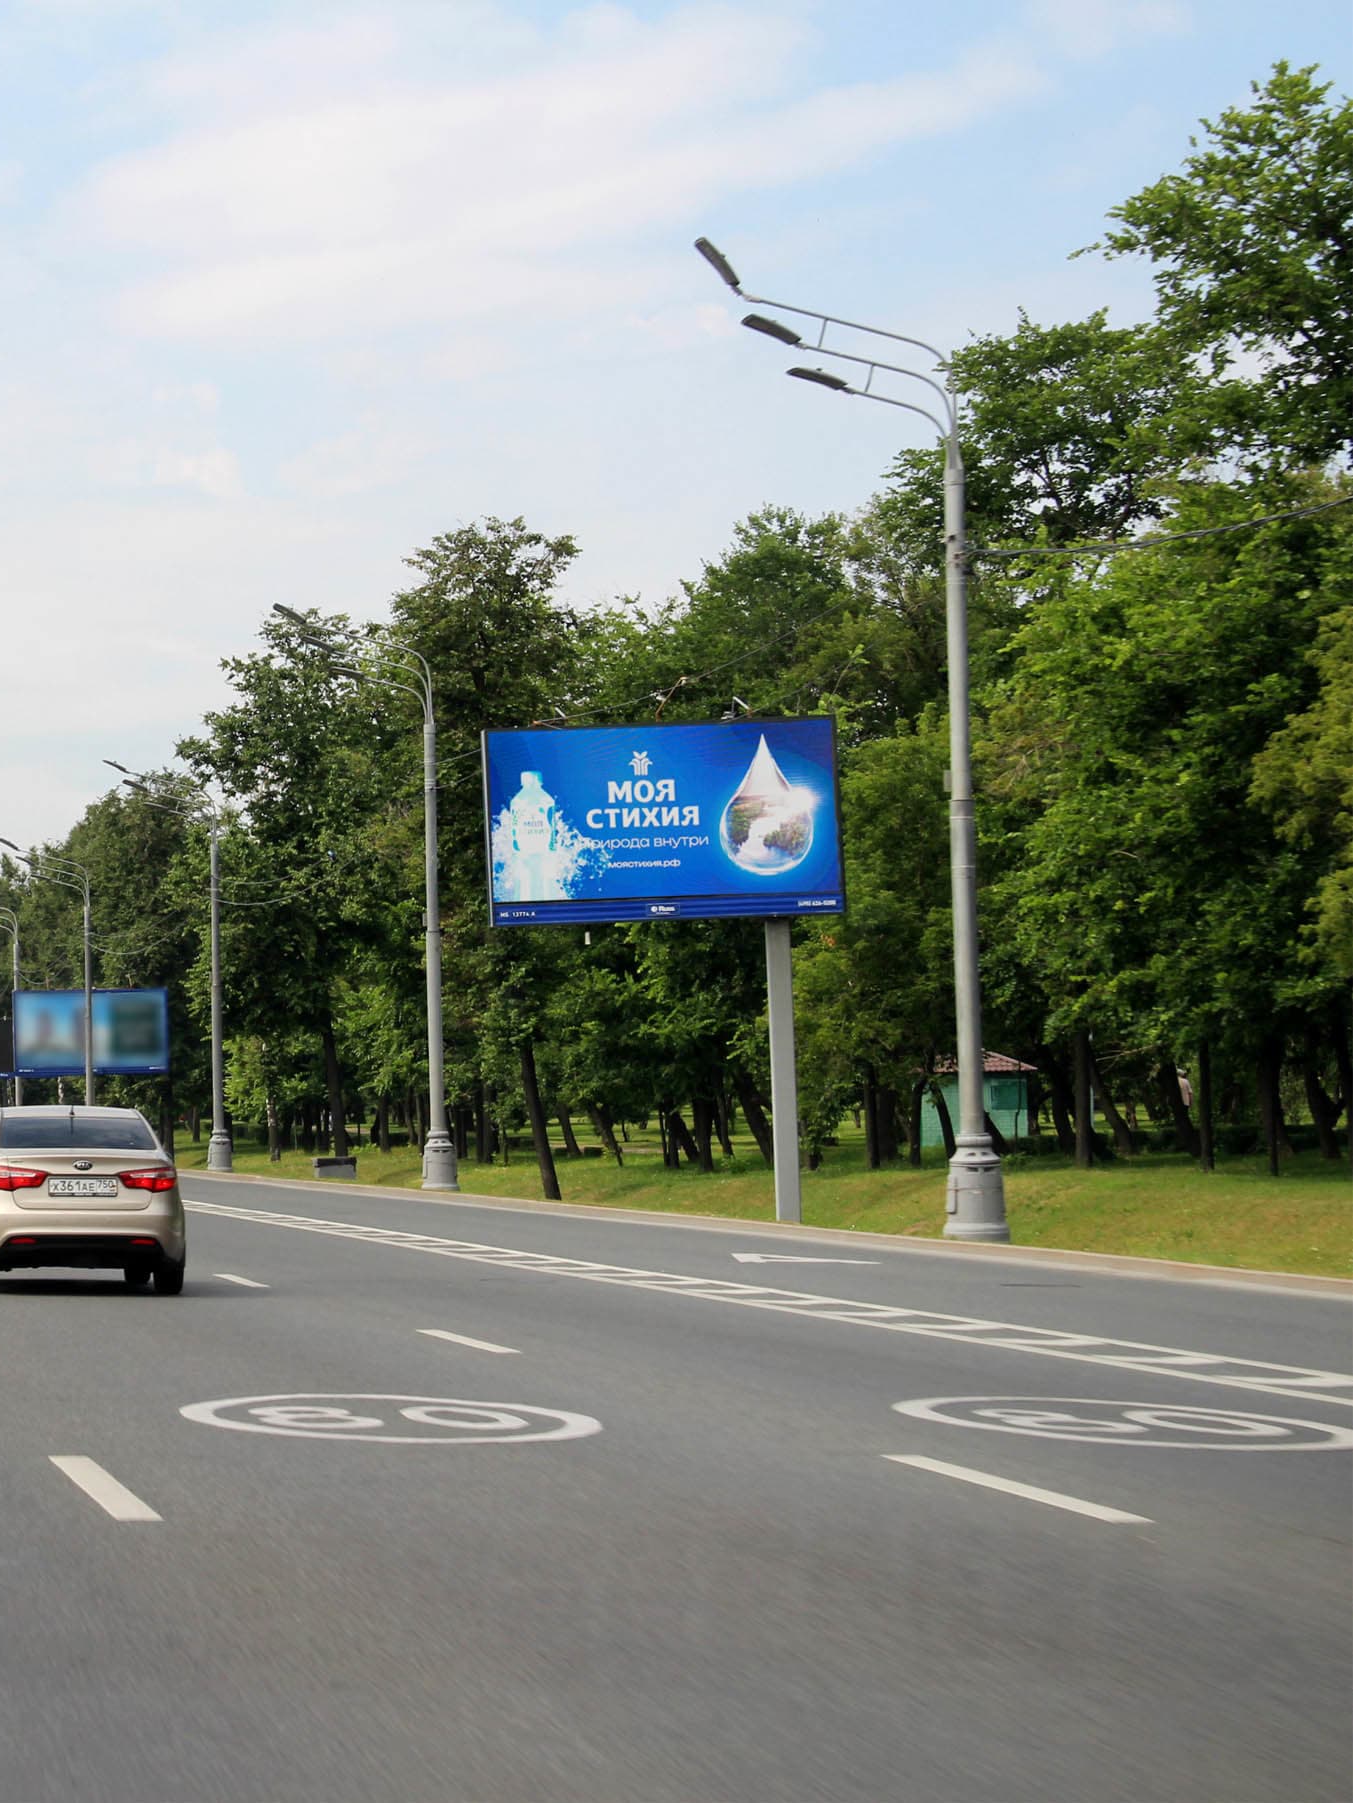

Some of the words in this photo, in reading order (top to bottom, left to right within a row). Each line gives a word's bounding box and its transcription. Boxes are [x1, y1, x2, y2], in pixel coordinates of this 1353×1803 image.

[607, 779, 676, 804] МОЯ
[586, 805, 700, 829] СТИХИЯ
[653, 835, 710, 848] внутри
[248, 1405, 530, 1431] 80
[971, 1408, 1293, 1436] 80
